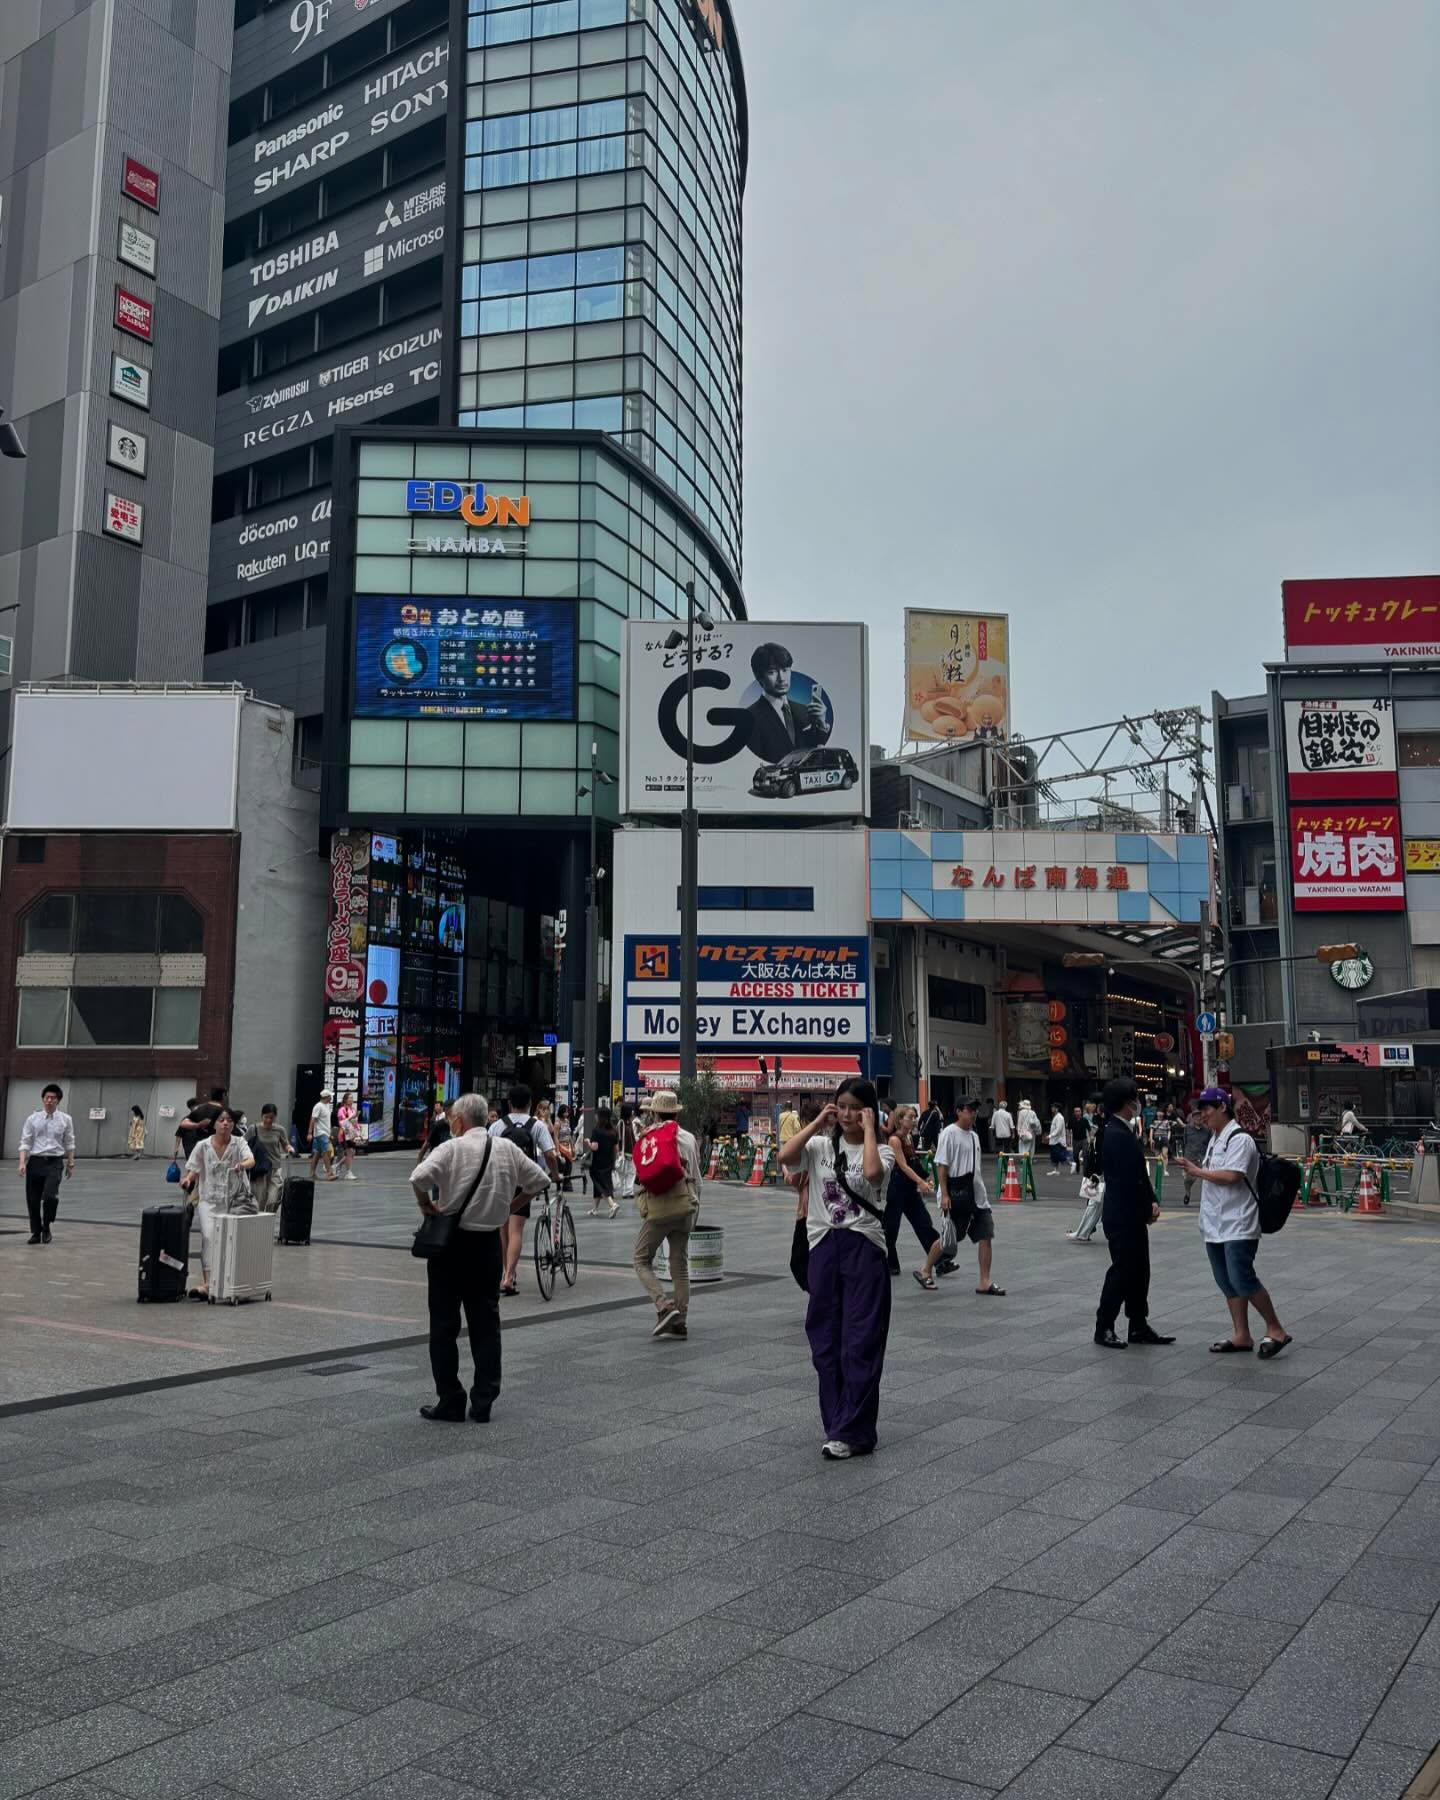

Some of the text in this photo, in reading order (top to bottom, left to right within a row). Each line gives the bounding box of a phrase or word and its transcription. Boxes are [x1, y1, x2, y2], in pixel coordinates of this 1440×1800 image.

[290, 0, 332, 54] 9F
[370, 79, 448, 135] SONY
[254, 104, 343, 162] Panasonic
[254, 131, 349, 195] SHARP
[250, 230, 339, 286] TOSHIBA
[265, 268, 338, 316] DAIKIN
[331, 355, 369, 383] TIGER
[327, 382, 394, 417] Hisense
[243, 409, 314, 449] REGZA
[406, 480, 530, 527] EDION
[239, 514, 298, 545] docomo
[294, 540, 317, 562] UQ
[426, 536, 506, 553] NAMBA
[237, 553, 287, 581] Rakuten
[437, 608, 526, 628] おとめ座
[1372, 700, 1391, 711] 4F
[1302, 712, 1380, 740] 目利きの
[1305, 737, 1365, 768] 銀次
[665, 775, 713, 784] タクシアプリ
[803, 774, 822, 785] TAXI
[1297, 831, 1396, 877] 焼肉
[952, 864, 1130, 890] なんば南海通
[1307, 885, 1345, 893] YAKINIKU
[1358, 885, 1391, 893] WATAMI
[741, 963, 857, 980] 大阪なんば本店
[730, 983, 859, 998] ACCESS TICKET
[644, 1008, 851, 1038] Moey EXchange
